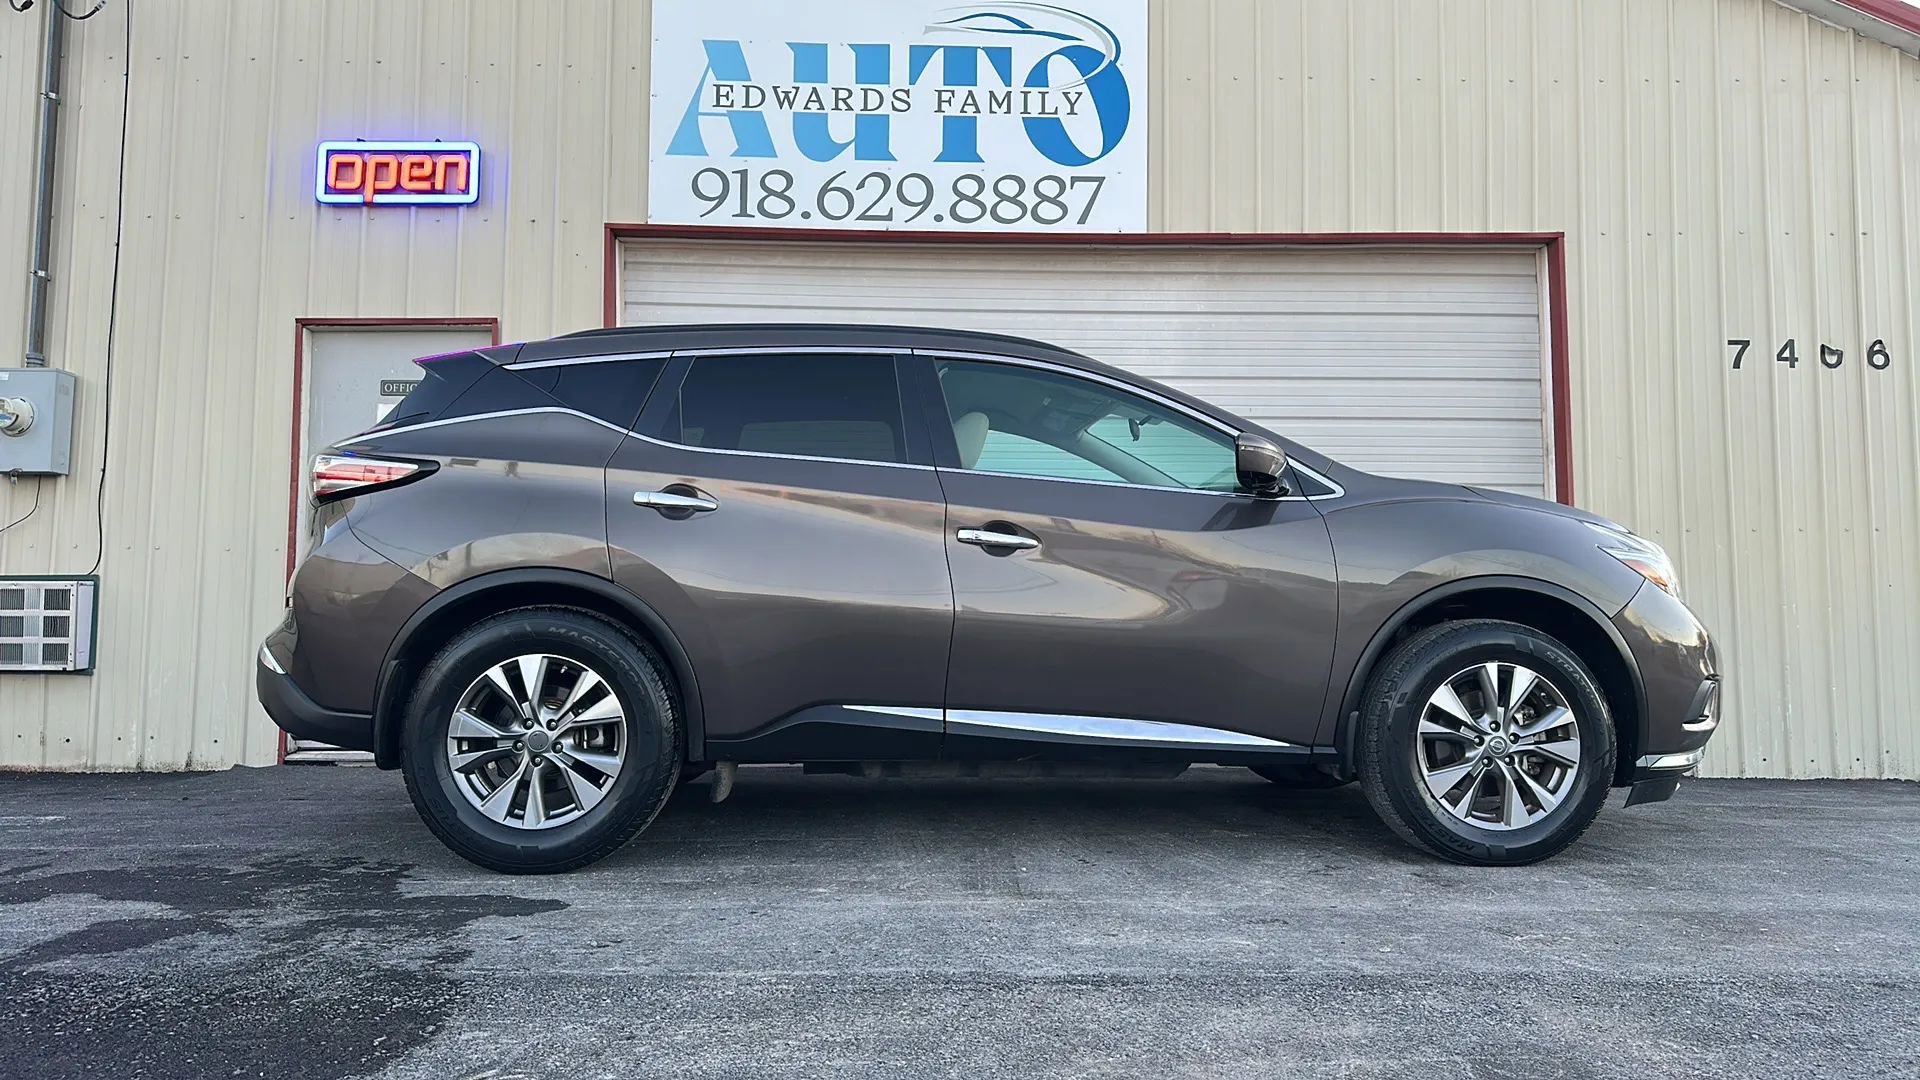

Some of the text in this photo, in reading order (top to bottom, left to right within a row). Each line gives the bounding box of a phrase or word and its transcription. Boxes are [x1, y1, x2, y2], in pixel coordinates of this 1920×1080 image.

[665, 40, 1130, 166] AUTO
[712, 84, 1083, 116] EDWARDS FAMILY
[691, 167, 1106, 224] 918.629.8887
[384, 383, 418, 393] OFFIC
